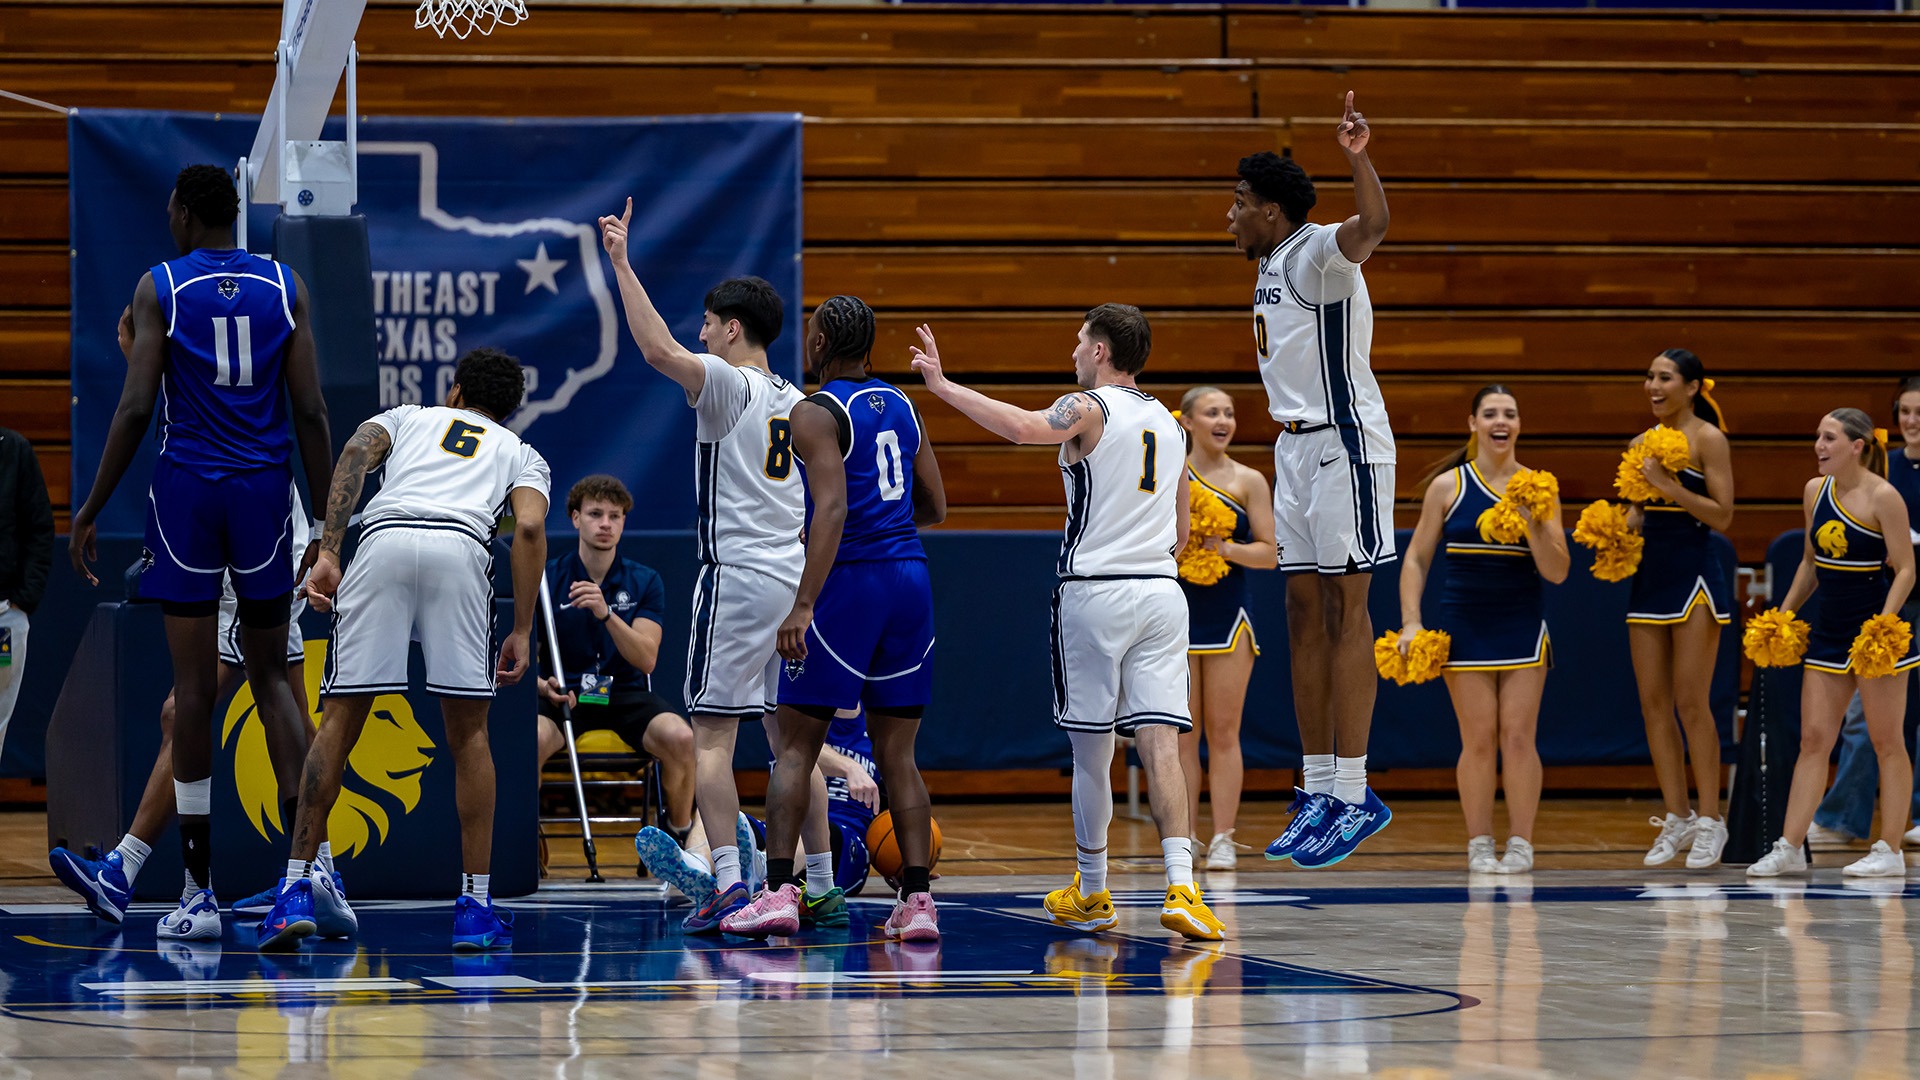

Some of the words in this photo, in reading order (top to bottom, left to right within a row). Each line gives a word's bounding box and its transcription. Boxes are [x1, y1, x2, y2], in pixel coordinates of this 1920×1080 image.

[372, 270, 500, 316] THEAST
[1254, 287, 1282, 306] ONS
[211, 315, 254, 386] 11
[375, 317, 458, 362] XAS
[379, 364, 423, 408] RS
[435, 364, 539, 408] CP
[439, 418, 487, 459] 6
[764, 415, 793, 481] 8
[1138, 428, 1158, 495] 1
[875, 429, 905, 501] 0
